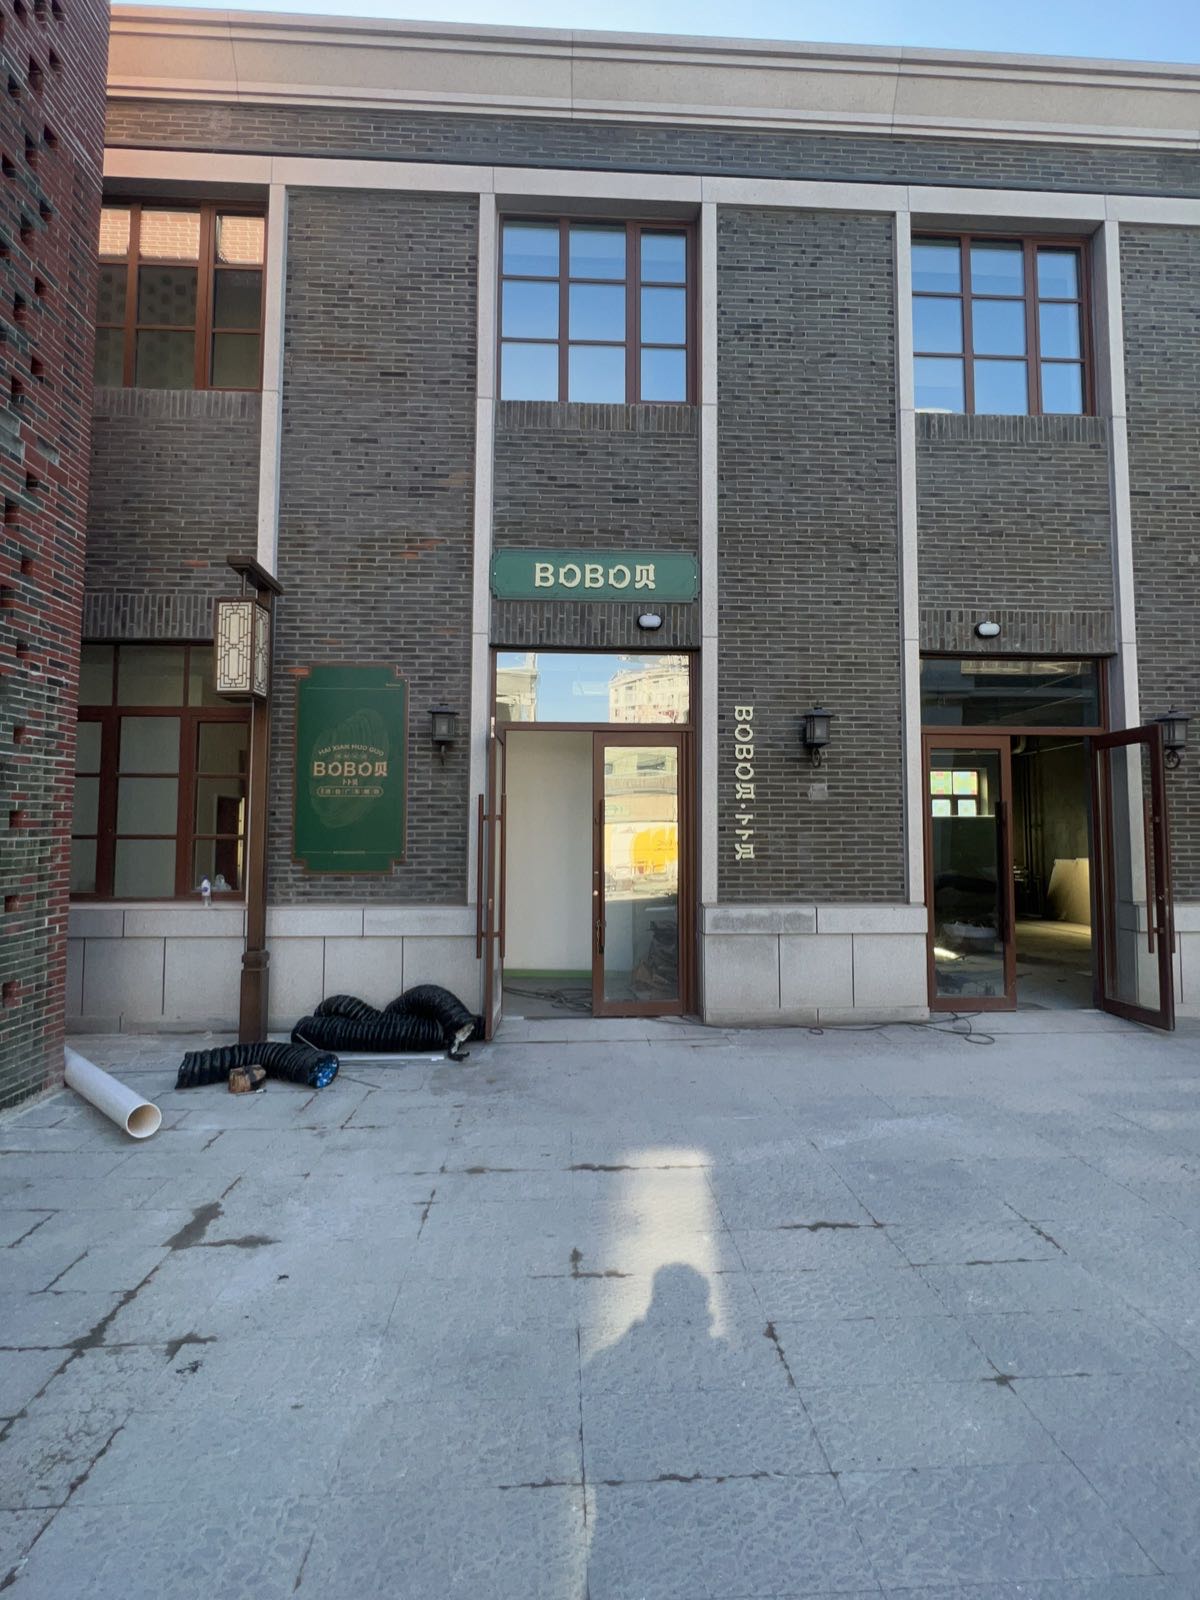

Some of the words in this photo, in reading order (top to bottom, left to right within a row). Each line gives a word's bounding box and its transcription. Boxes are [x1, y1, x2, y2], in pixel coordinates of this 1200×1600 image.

[318, 746, 331, 755] HAI
[332, 744, 350, 752] XIAN
[368, 747, 384, 756] GUO
